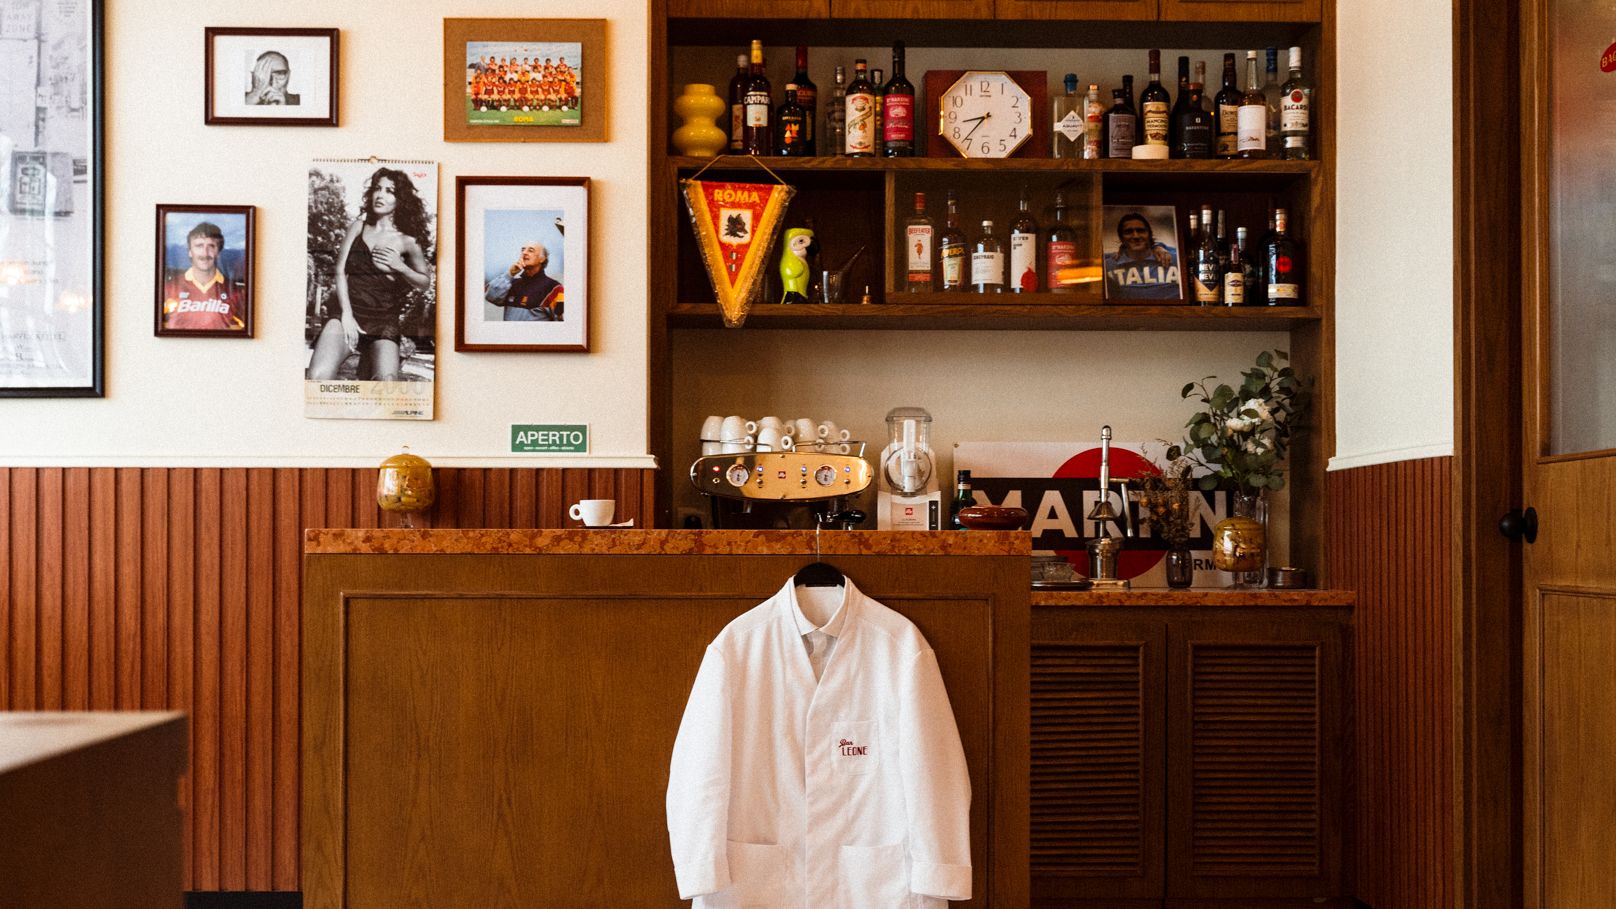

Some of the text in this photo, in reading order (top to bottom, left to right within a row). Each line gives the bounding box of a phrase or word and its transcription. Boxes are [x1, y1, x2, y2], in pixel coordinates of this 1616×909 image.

[965, 84, 972, 96] 11
[980, 81, 990, 93] 12
[952, 96, 964, 108] 10
[1011, 96, 1019, 108] 2
[948, 111, 957, 124] 9
[1014, 112, 1022, 124] 3
[952, 127, 960, 139] 8
[1009, 127, 1017, 139] 4
[964, 138, 973, 151] 7
[981, 142, 990, 154] 6
[999, 139, 1007, 152] 5
[713, 188, 761, 204] ROMA
[177, 298, 230, 314] Barilla
[320, 384, 360, 394] DICEMBRE
[515, 431, 583, 444] APERTO
[842, 746, 869, 756] LEONE
